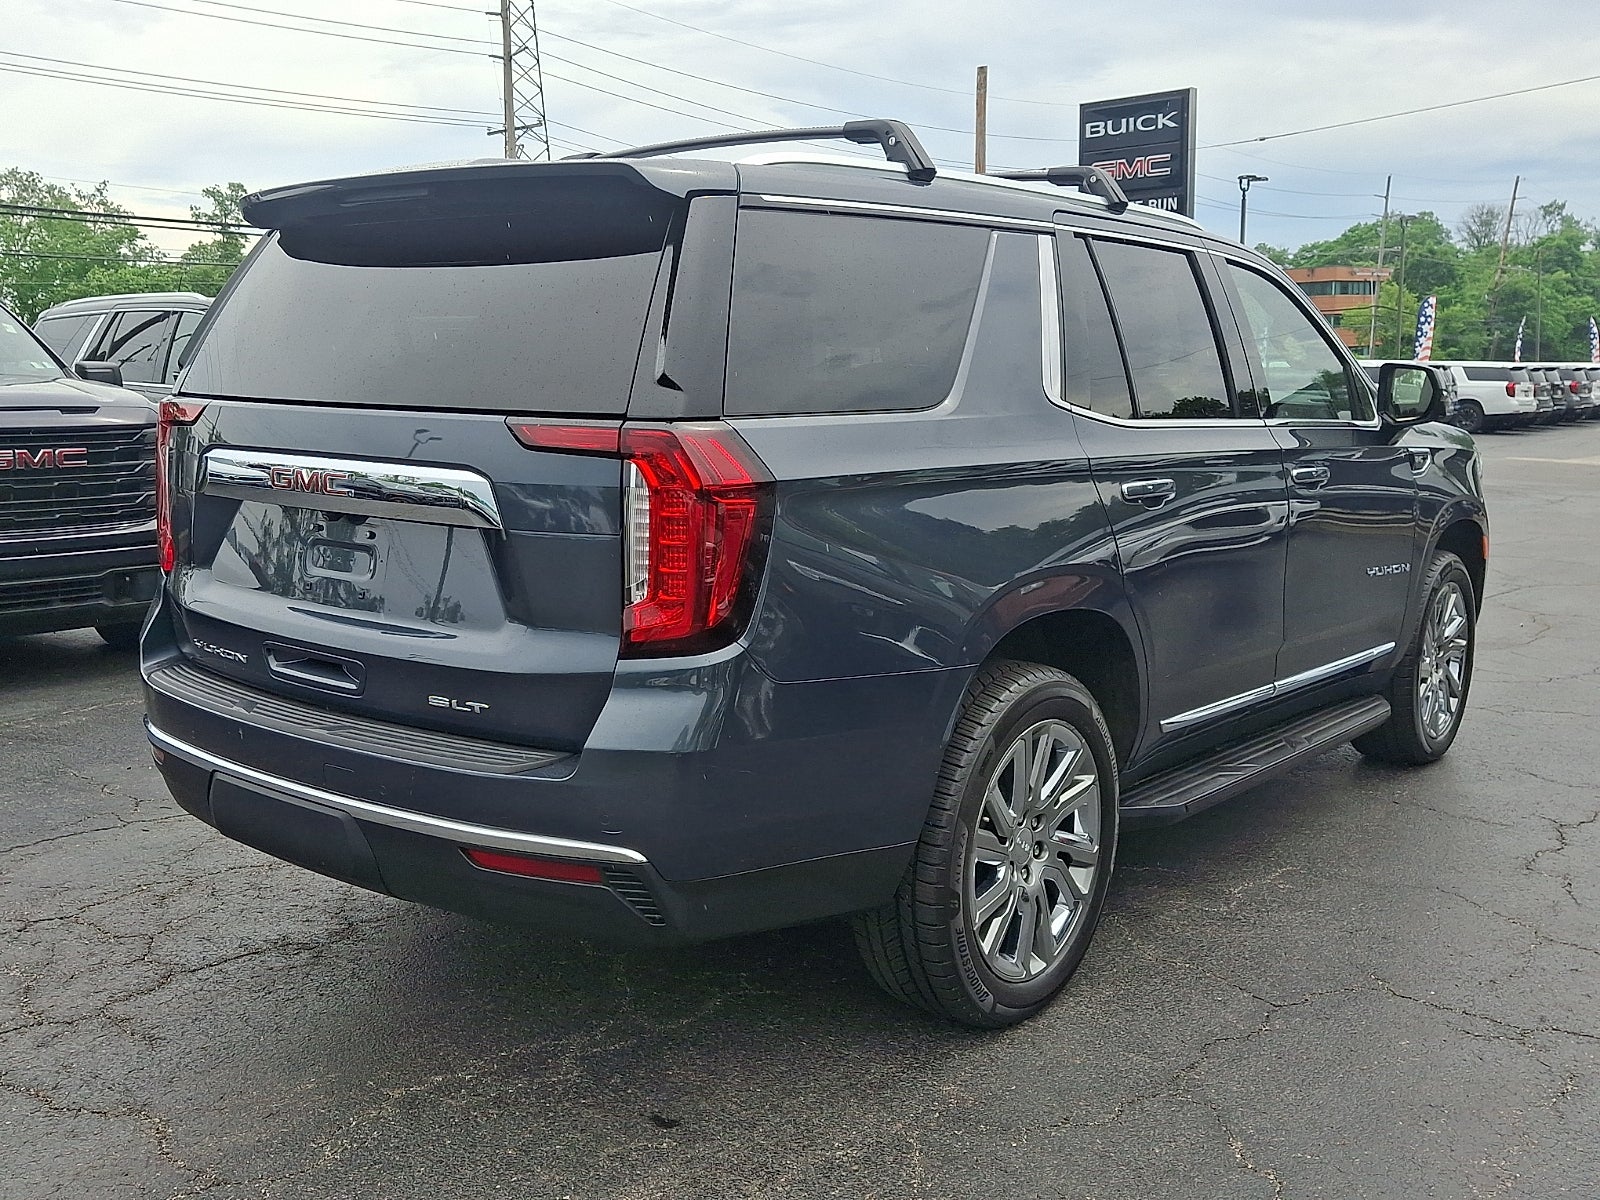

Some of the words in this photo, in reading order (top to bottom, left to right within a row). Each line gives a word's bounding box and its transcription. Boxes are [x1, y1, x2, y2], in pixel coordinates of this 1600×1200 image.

[1085, 111, 1179, 138] BUICK
[1091, 153, 1171, 181] GMC
[270, 466, 348, 497] GMC
[1366, 562, 1411, 577] YUKON
[193, 638, 248, 663] YUKON
[428, 695, 490, 714] SLT
[955, 926, 991, 1004] BRIDGESTONE
